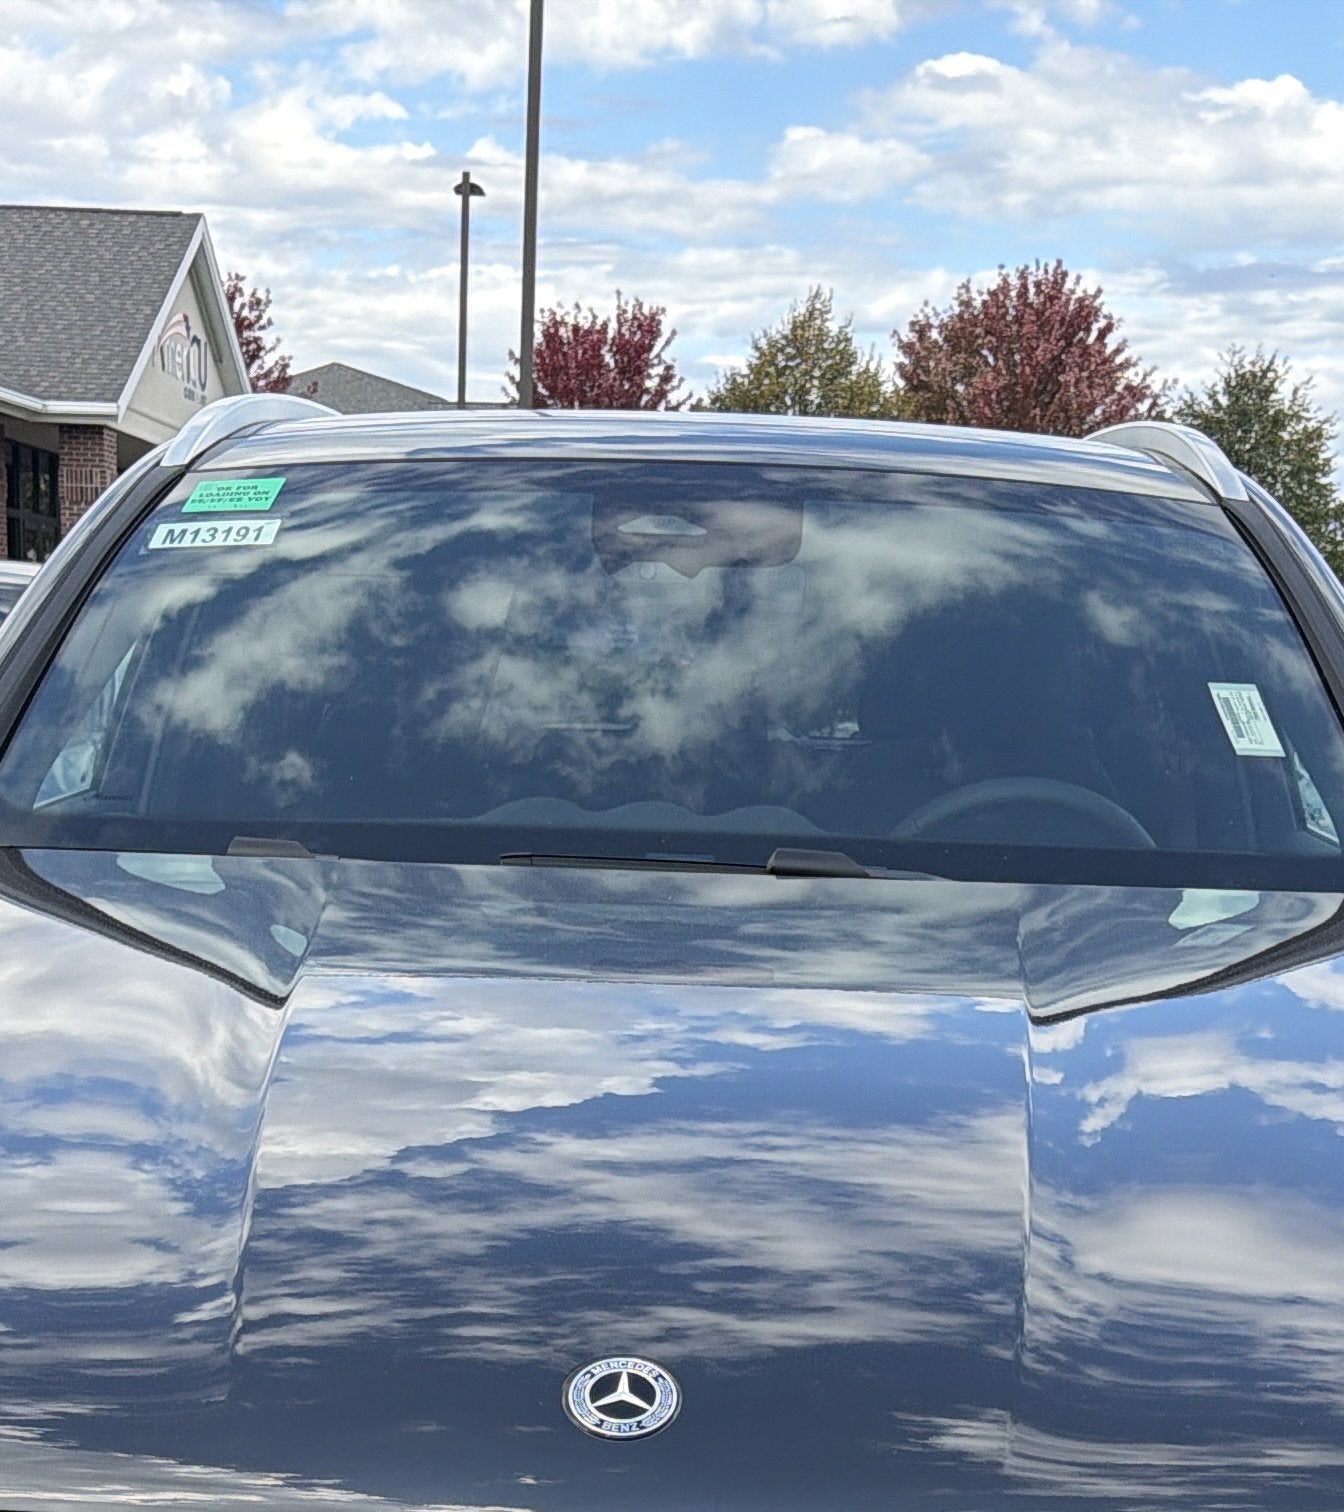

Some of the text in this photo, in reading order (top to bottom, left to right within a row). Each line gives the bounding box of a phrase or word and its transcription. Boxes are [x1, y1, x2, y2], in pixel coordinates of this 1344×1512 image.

[161, 526, 265, 545] M13191
[590, 1359, 660, 1379] MERCEDES
[601, 1421, 640, 1432] BENZ
